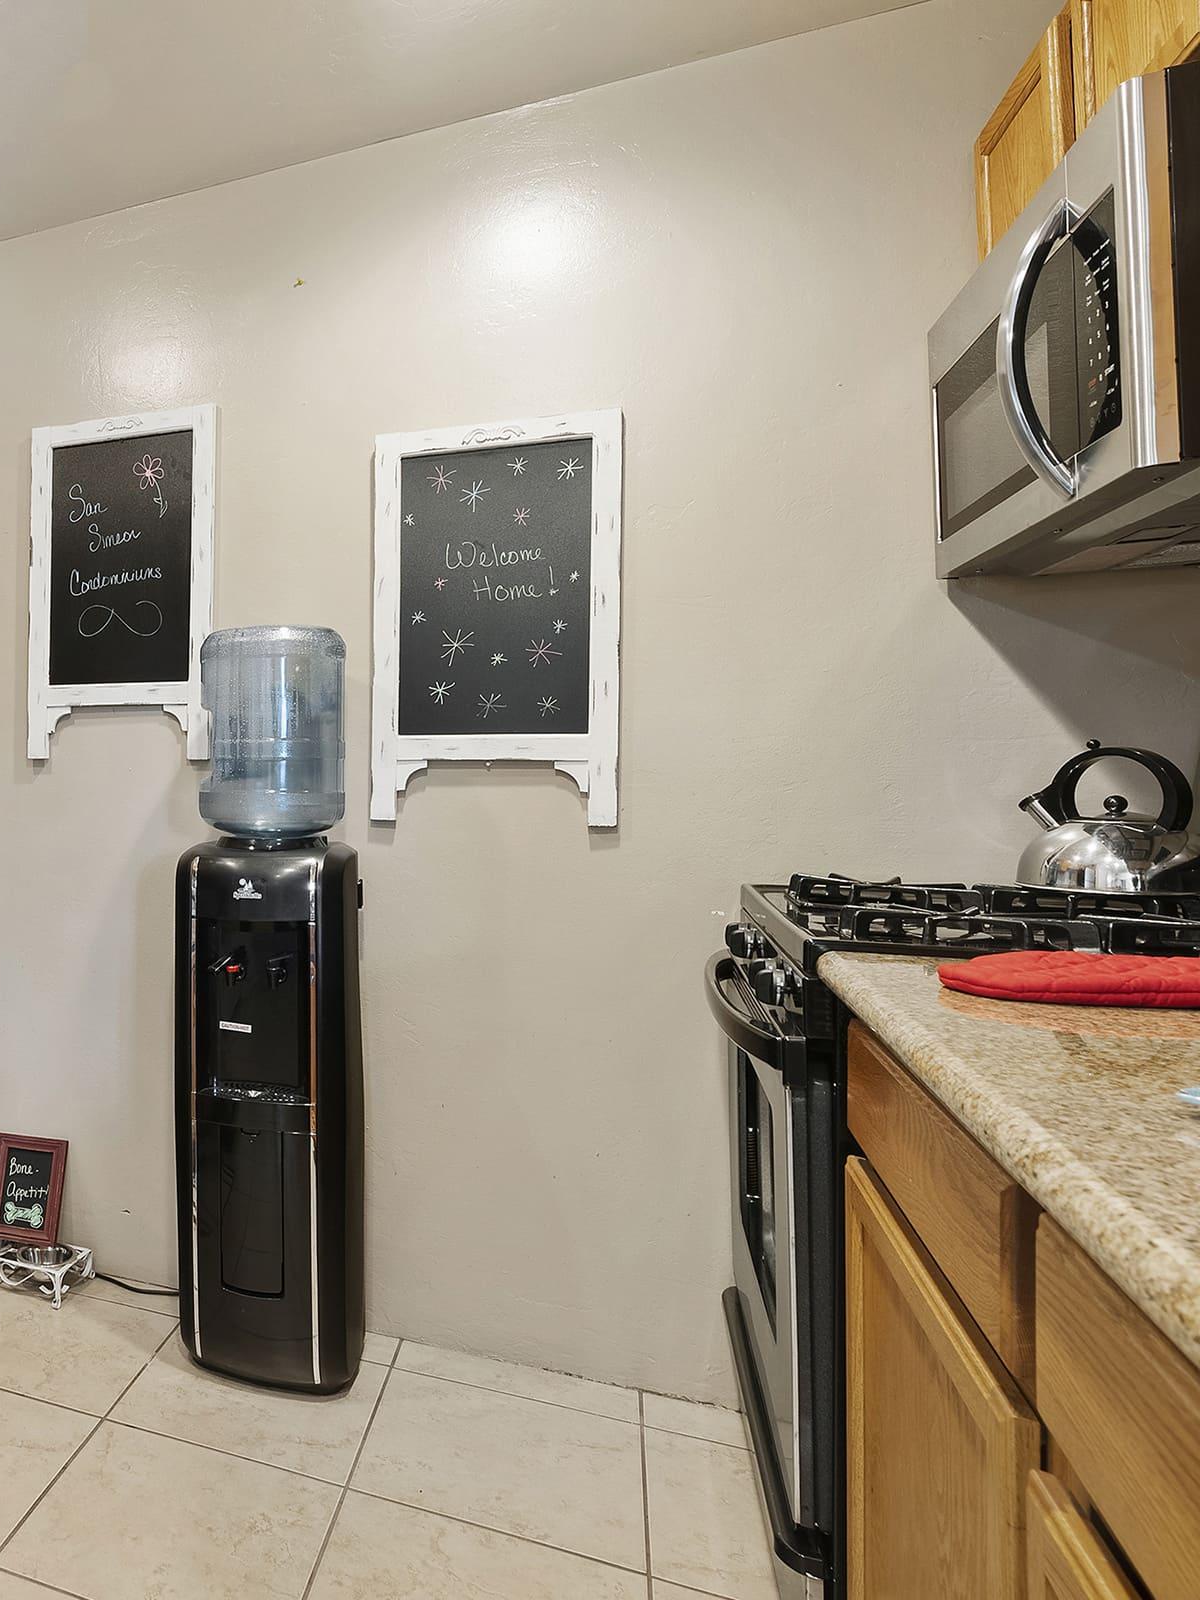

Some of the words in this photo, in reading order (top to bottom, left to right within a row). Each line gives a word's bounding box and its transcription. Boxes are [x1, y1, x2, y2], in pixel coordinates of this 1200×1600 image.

[68, 483, 108, 523] San
[445, 541, 546, 570] Welcome
[69, 566, 162, 597] Condominiums
